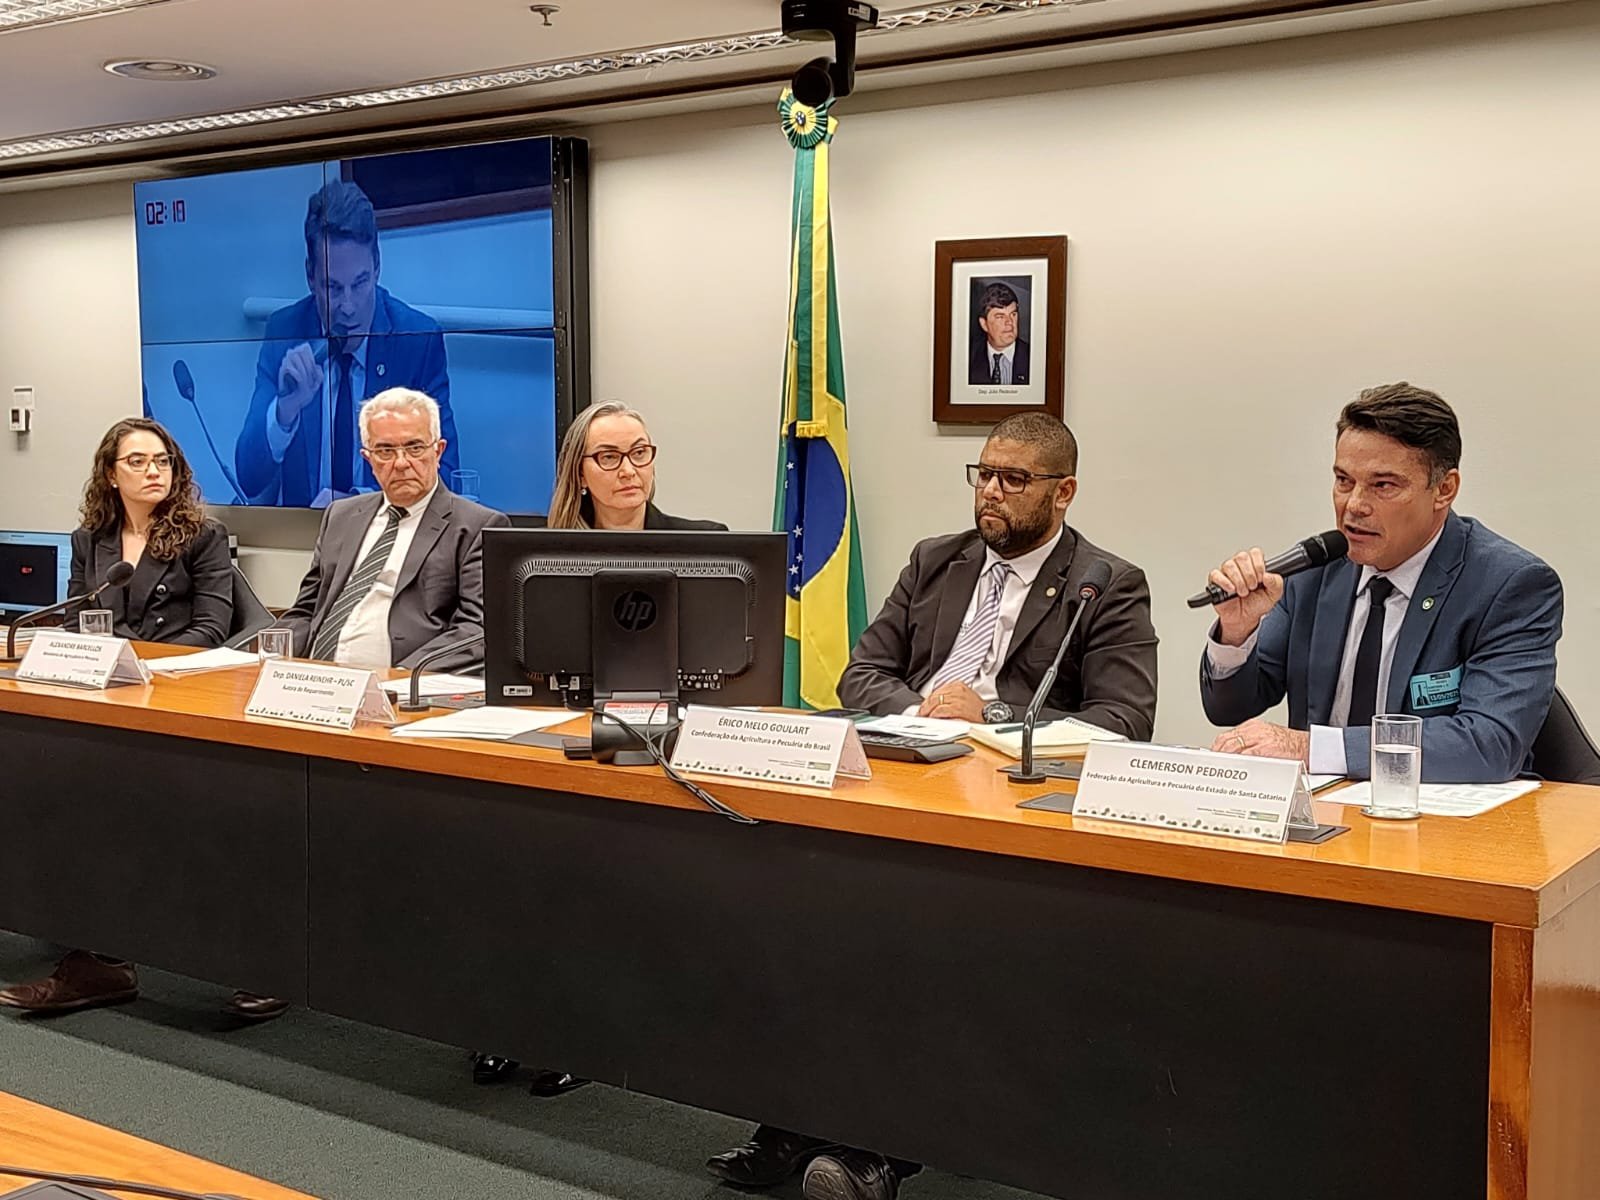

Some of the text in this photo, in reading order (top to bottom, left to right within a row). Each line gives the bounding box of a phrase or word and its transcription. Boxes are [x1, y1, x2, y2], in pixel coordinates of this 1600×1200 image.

[619, 590, 652, 632] hp
[286, 672, 309, 681] DANIELA
[718, 716, 810, 734] ÉRICO MELO GOULART
[691, 730, 730, 740] Confederação
[739, 734, 771, 744] Agricultura
[777, 739, 803, 748] Pecuária
[1130, 758, 1248, 780] CLEMERSON PEDROZO
[1087, 772, 1117, 782] Federação
[1127, 776, 1160, 786] Agricultura
[1168, 781, 1194, 790] Pecuária
[1206, 786, 1227, 795] Estado
[1238, 790, 1256, 798] Santa
[1258, 792, 1286, 801] Catarina
